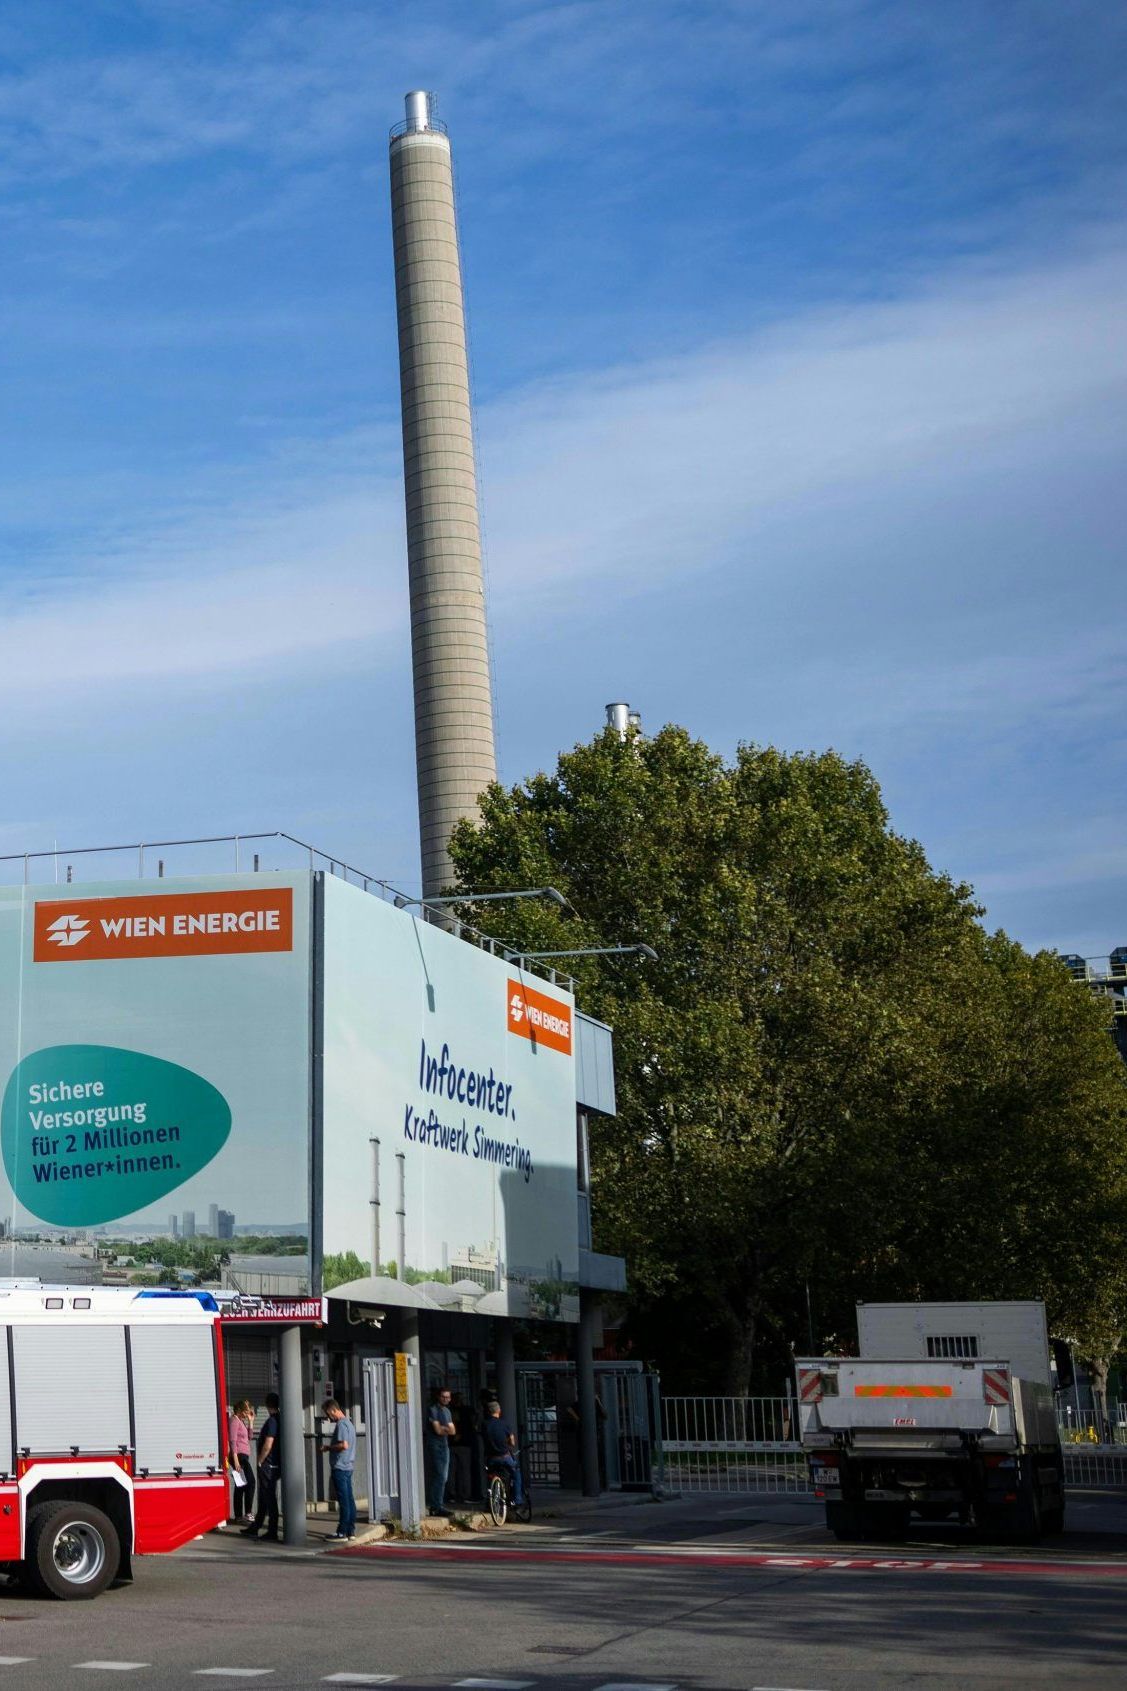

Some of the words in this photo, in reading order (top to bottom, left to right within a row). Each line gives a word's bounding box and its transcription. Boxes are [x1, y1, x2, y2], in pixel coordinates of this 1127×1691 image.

[99, 916, 166, 939] WIEN
[172, 910, 281, 936] ENERGIE
[524, 1003, 543, 1028] WIEN
[543, 1010, 570, 1038] ENERGIE
[28, 1080, 104, 1105] Sichere
[419, 1037, 515, 1121] Infocenter.
[28, 1102, 147, 1130] Versorgung
[31, 1135, 59, 1156] für
[65, 1134, 77, 1153] 2
[83, 1125, 181, 1151] Millionen
[403, 1103, 469, 1156] Kraftwerk
[472, 1125, 534, 1183] Simmering.
